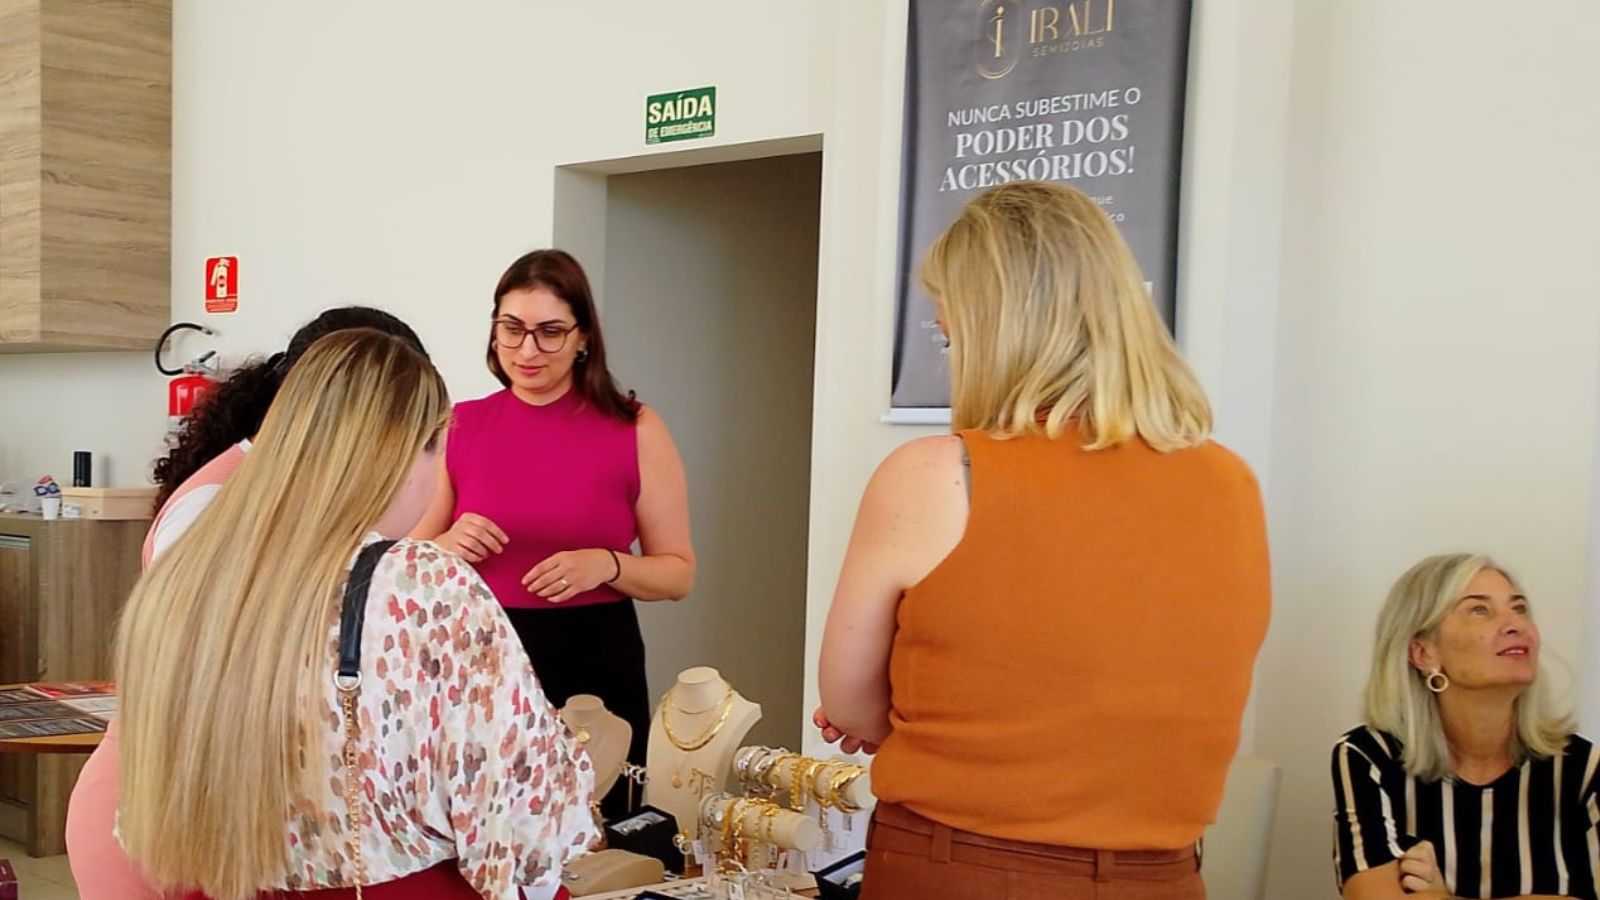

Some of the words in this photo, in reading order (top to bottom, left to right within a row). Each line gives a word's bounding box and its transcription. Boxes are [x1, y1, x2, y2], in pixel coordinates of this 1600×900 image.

[648, 94, 713, 124] SAÍDA
[947, 104, 1011, 127] NUNCA
[1015, 89, 1121, 119] SUBESTIME
[1124, 87, 1141, 105] O
[956, 123, 1055, 158] PODER
[1062, 114, 1129, 146] DOS
[939, 146, 1135, 192] ACESSÓRIOS!
